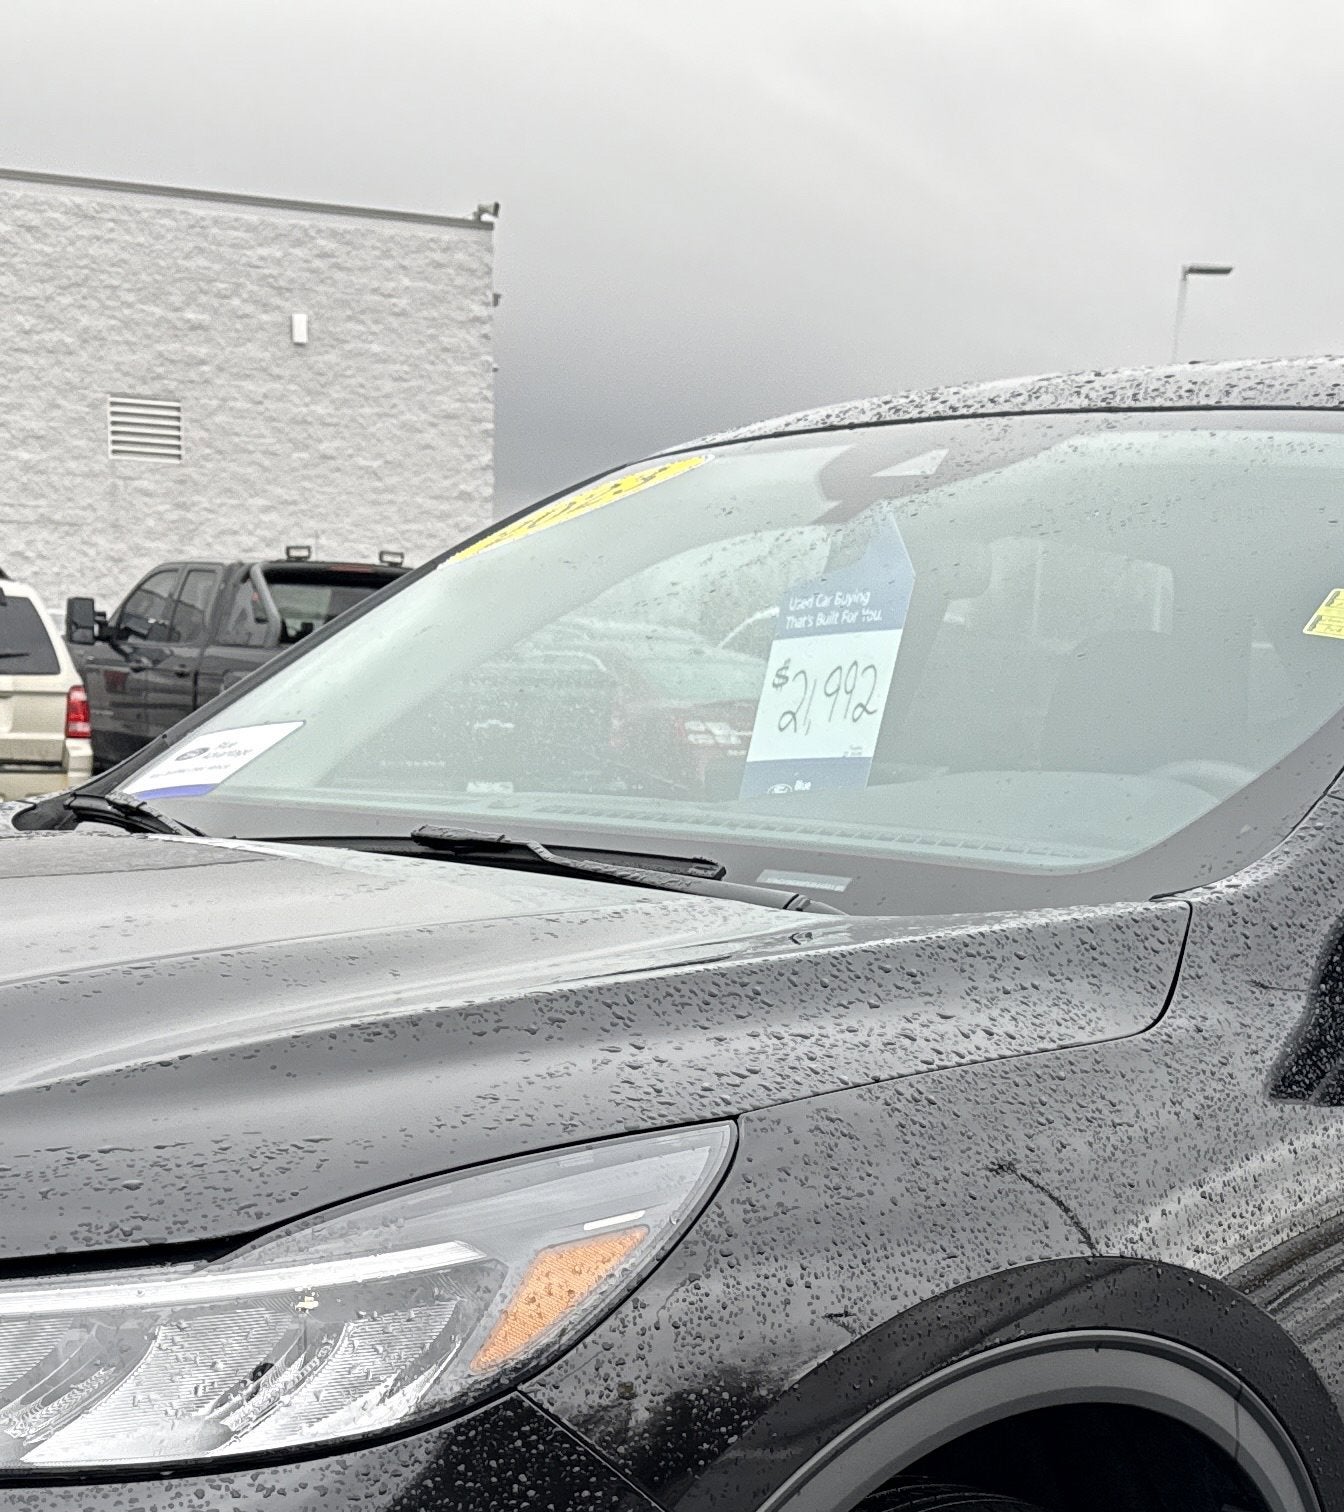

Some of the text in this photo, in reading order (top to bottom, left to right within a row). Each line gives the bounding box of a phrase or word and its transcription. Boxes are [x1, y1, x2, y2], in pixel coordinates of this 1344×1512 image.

[789, 590, 871, 612] Used Car Buying
[786, 614, 814, 630] That's
[815, 611, 839, 627] Built
[840, 610, 859, 624] For
